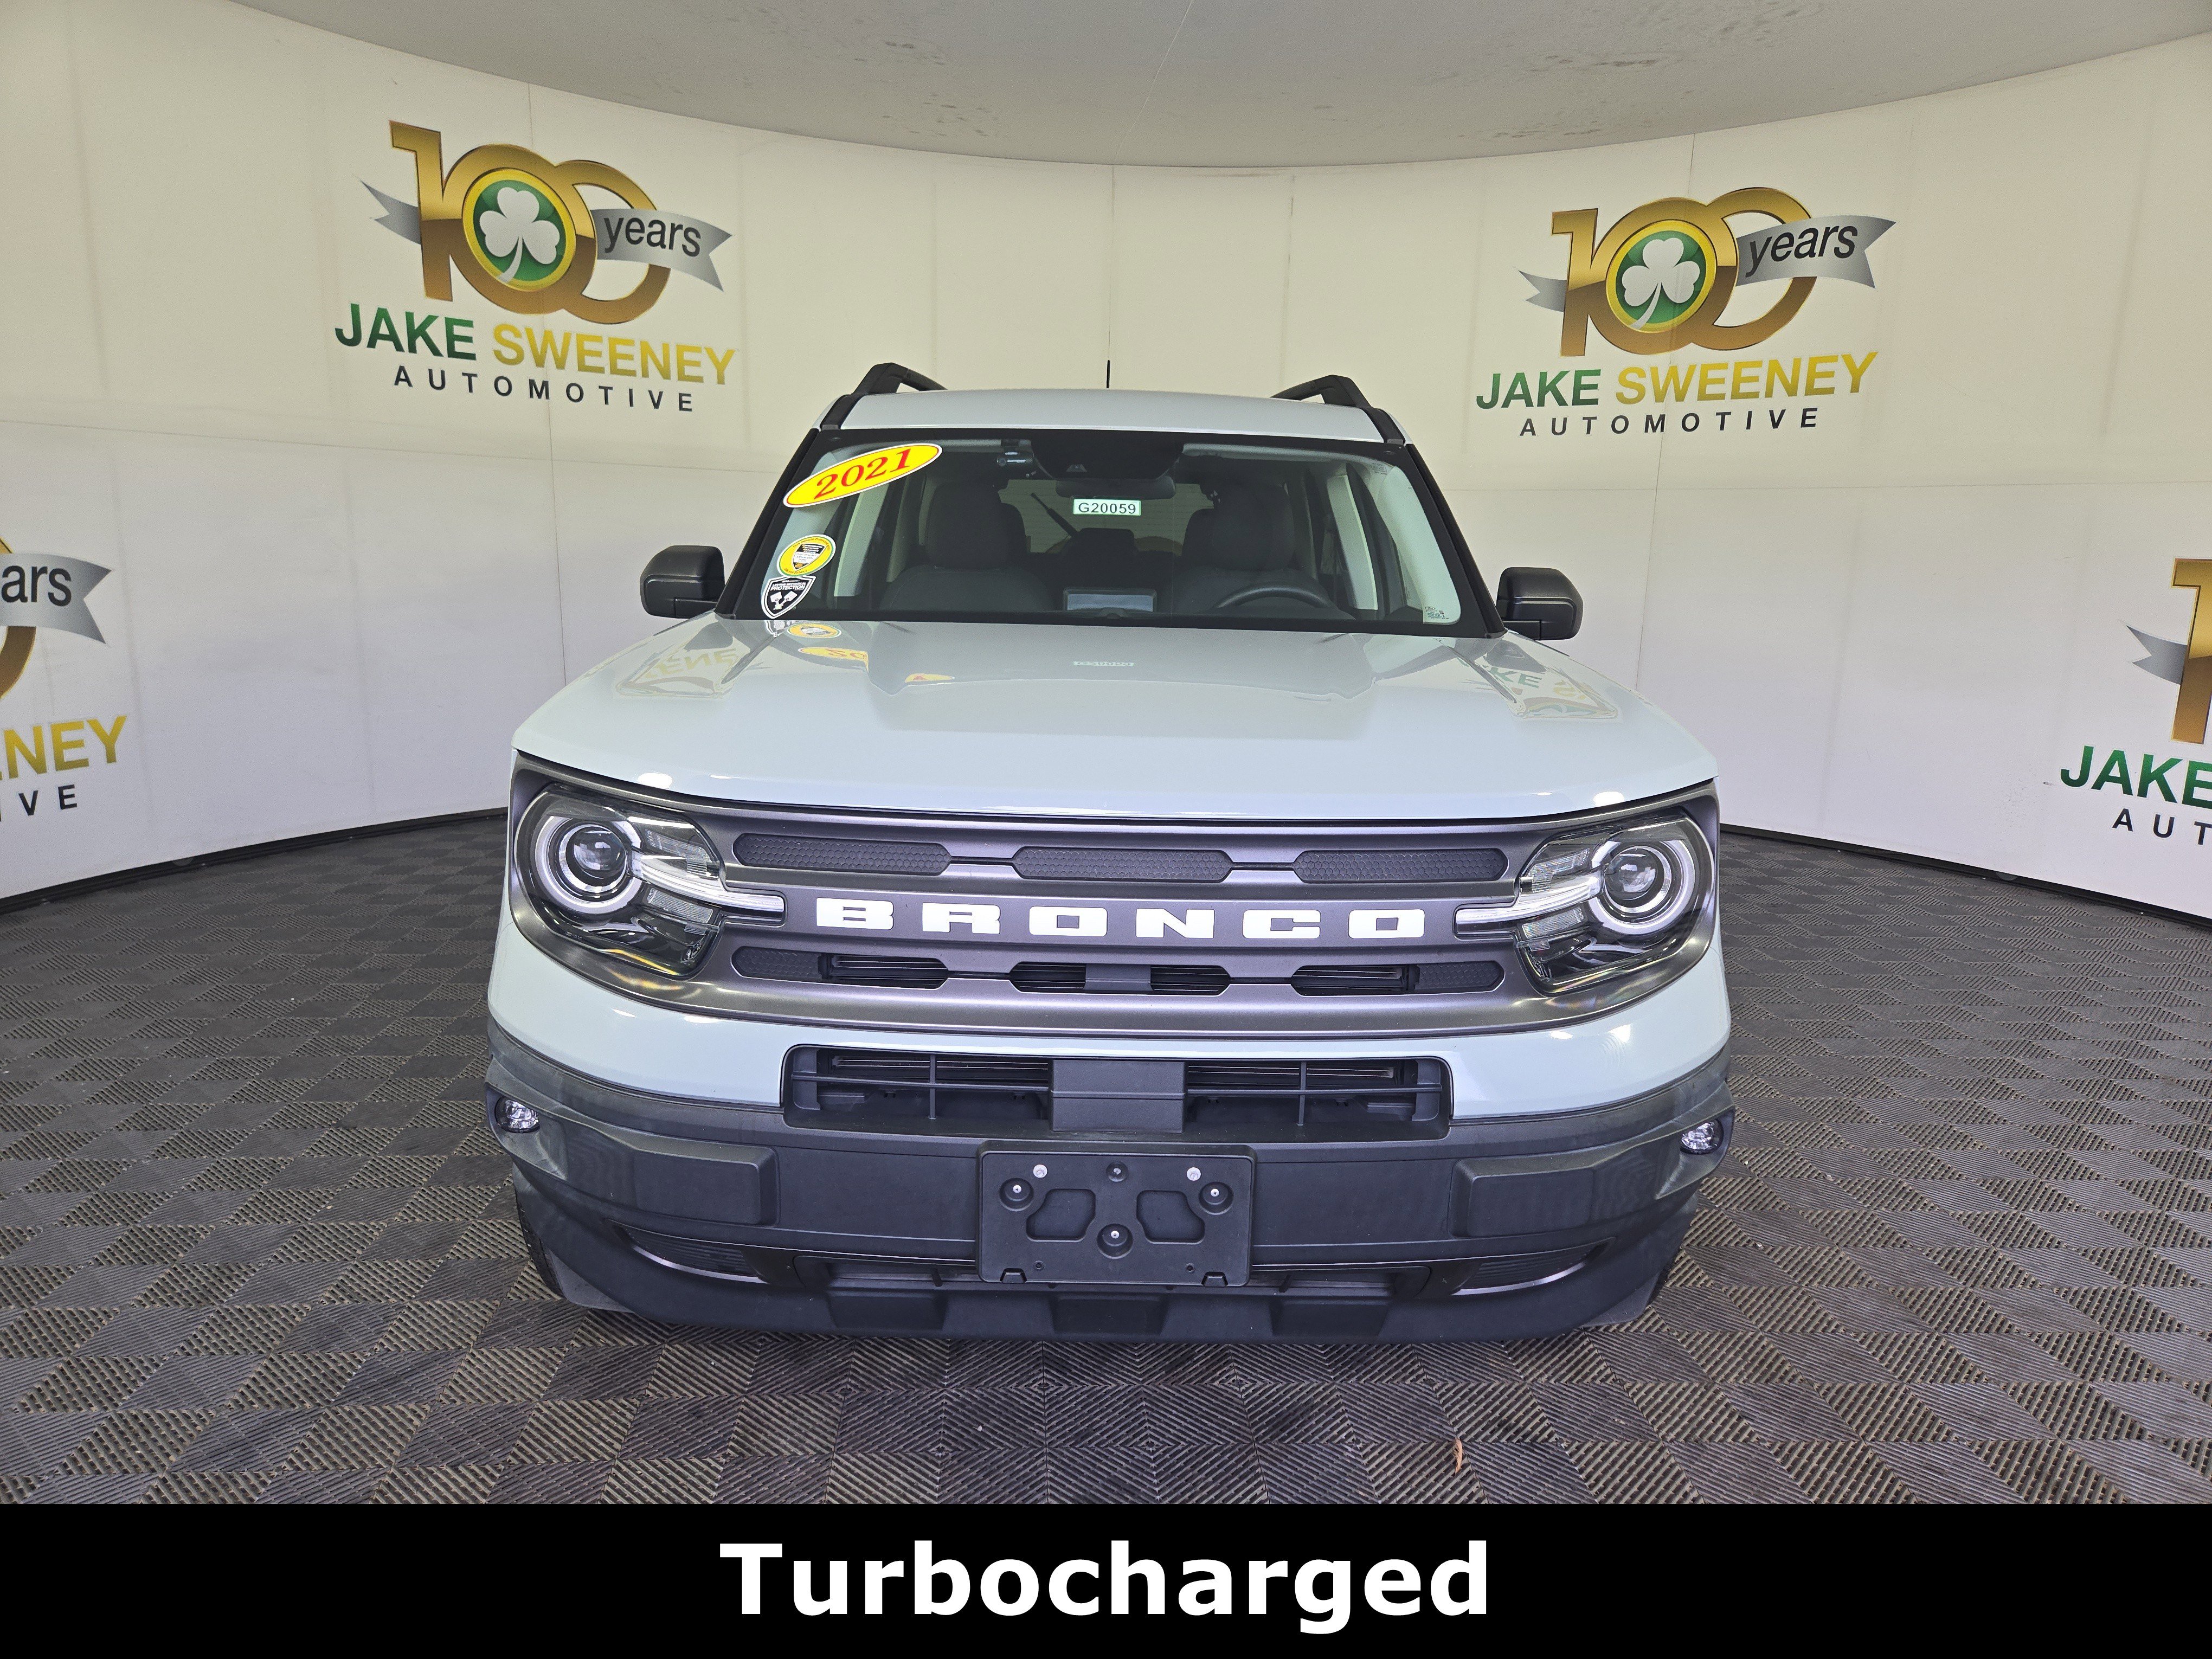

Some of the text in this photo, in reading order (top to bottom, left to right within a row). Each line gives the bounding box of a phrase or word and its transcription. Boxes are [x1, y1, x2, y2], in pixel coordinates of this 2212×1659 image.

[603, 217, 701, 258] years
[1745, 225, 1859, 278] years
[335, 303, 736, 385] JAKE SWEENEY
[394, 365, 693, 412] AUTOMOTIVE
[1476, 351, 1879, 410] JAKE SWEENEY
[1520, 408, 1818, 436] AUTOMOTIVE
[814, 448, 911, 499] 2021
[1078, 503, 1136, 514] G20059
[0, 715, 127, 780] NEY
[2060, 745, 2212, 809] JAKE
[0, 784, 78, 821] VE
[816, 897, 1425, 938] BRONCO
